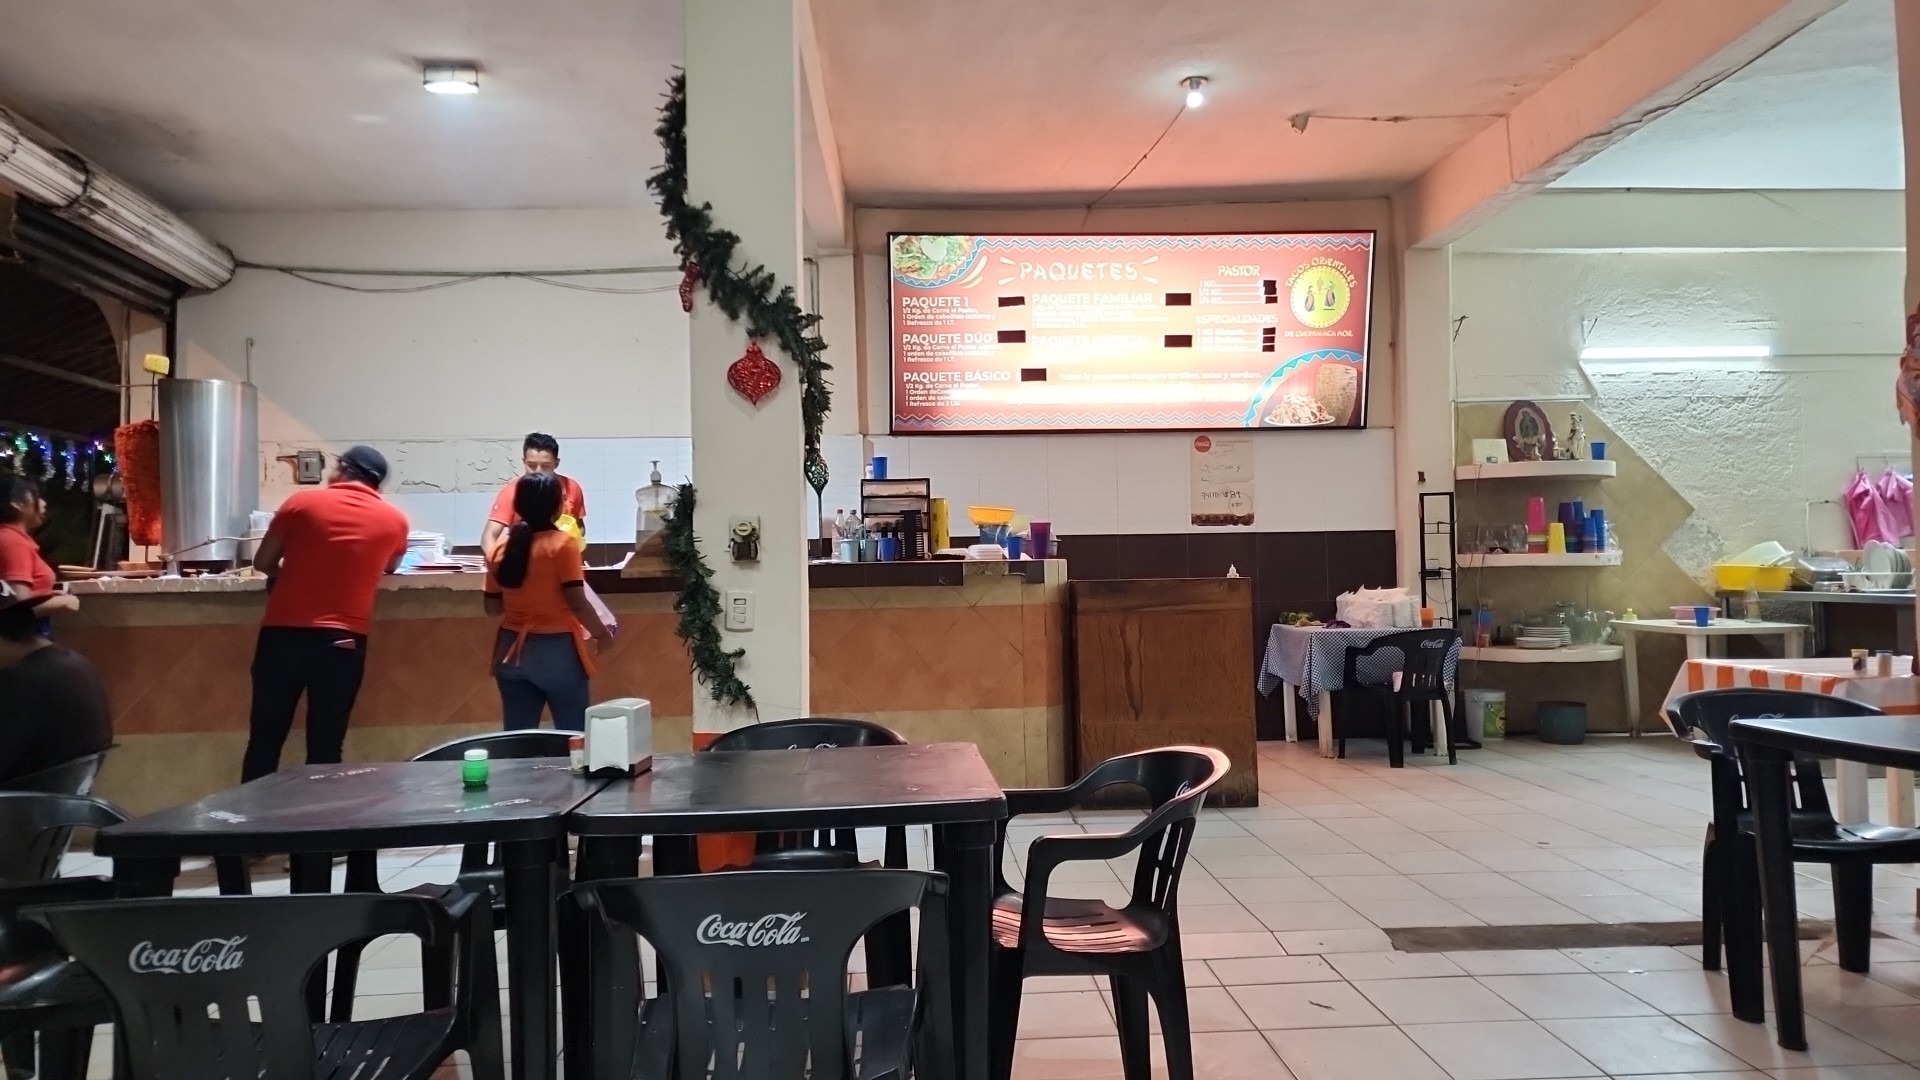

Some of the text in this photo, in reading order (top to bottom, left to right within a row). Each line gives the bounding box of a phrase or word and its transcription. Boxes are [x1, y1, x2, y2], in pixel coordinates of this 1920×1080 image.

[1019, 261, 1139, 282] PAQUETES
[1217, 265, 1261, 277] PASTOR
[1284, 256, 1358, 288] TACOS ORIENTALES
[902, 296, 969, 309] PAQUETE 1
[1031, 292, 1153, 307] PAQUETE FAMILIAR
[1195, 314, 1279, 324] ESPECIALIDADES
[902, 330, 994, 346] PAQUETE DÚO
[903, 368, 1011, 384] PAQUETE BÁSICO
[1420, 639, 1446, 649] Coca-Cola
[696, 911, 808, 948] Coca-Cola
[129, 935, 248, 975] Coca-Cola
